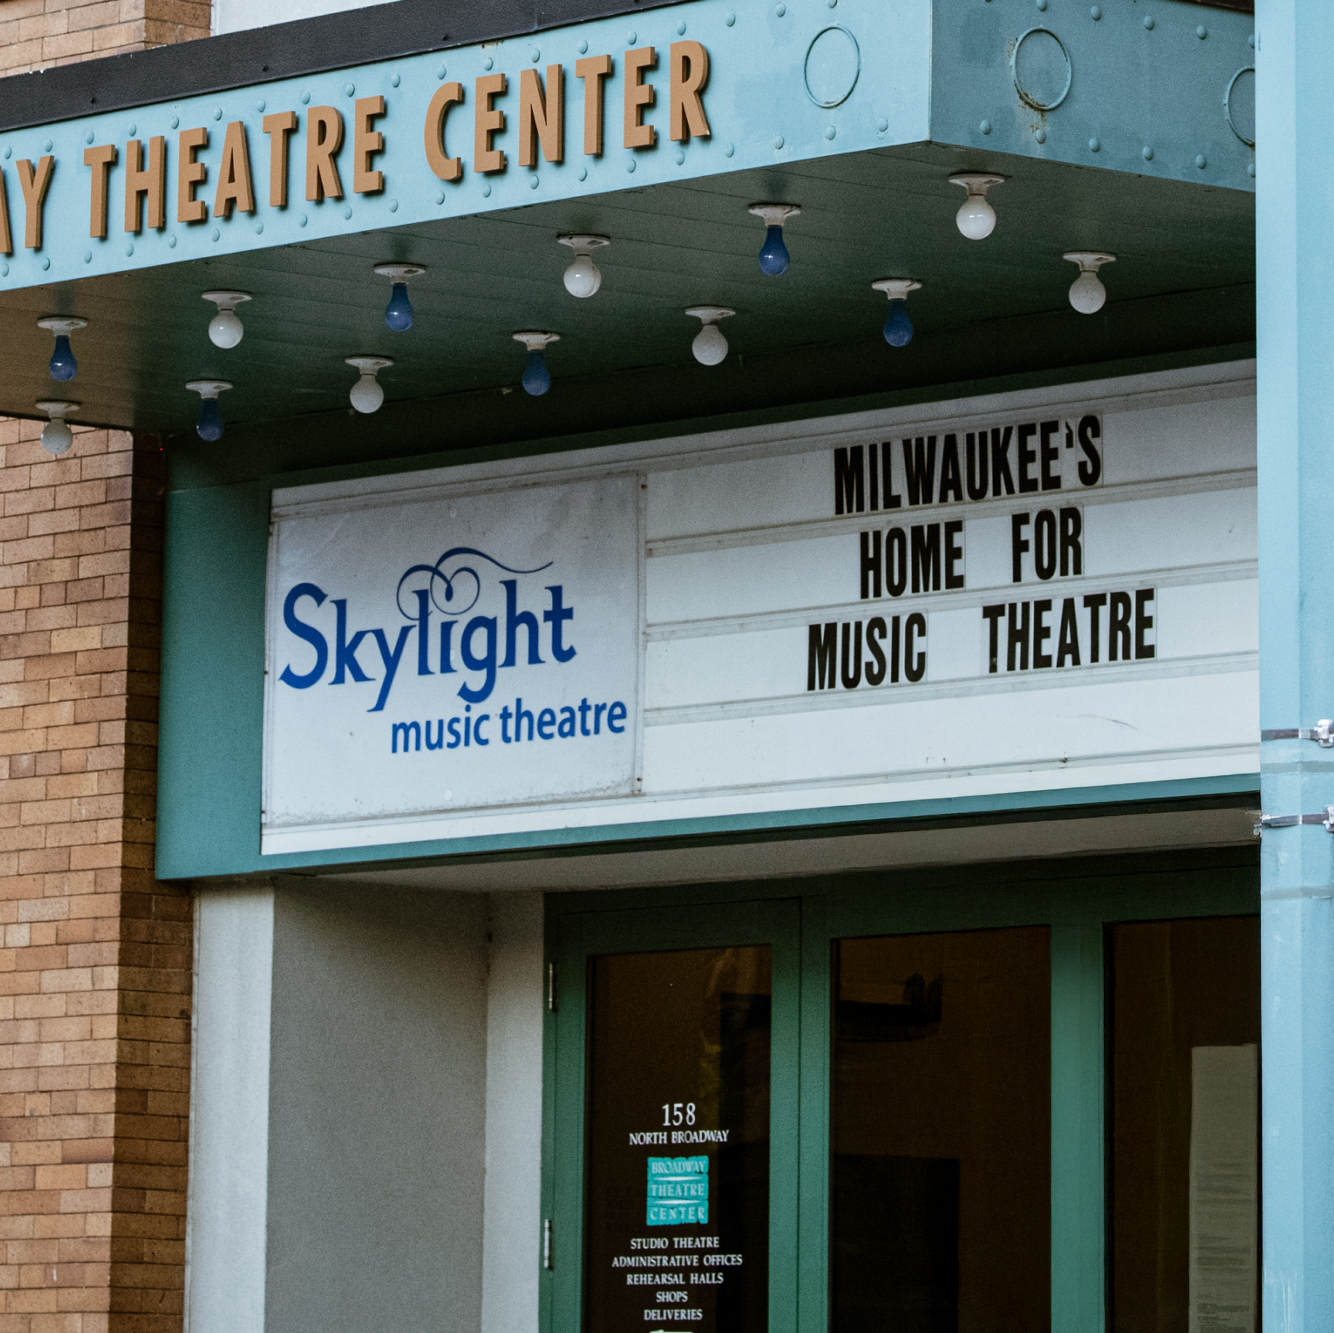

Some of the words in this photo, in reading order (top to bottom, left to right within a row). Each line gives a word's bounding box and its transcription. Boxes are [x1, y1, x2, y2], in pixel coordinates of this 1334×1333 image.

[83, 94, 385, 239] THEATRE
[424, 40, 711, 181] CENTER
[834, 414, 1103, 516] MILWAUKEE'S
[860, 520, 965, 599] HOME
[1011, 507, 1083, 583] FOR
[278, 547, 579, 712] Skylight
[807, 612, 927, 692] MUSIC
[983, 588, 1156, 674] THEATRE
[391, 704, 491, 754] music
[498, 693, 628, 745] theatre
[662, 1102, 696, 1126] 158
[629, 1132, 668, 1145] NORTH
[671, 1129, 730, 1144] BROADWAY
[651, 1161, 706, 1174] BROADWAY
[651, 1183, 705, 1197] THEATRE
[650, 1207, 705, 1220] CENTER
[630, 1238, 669, 1250] STUDIO
[673, 1237, 720, 1249] THEATRE
[612, 1255, 699, 1268] ADMINISTRATIVE
[703, 1254, 743, 1266] OFFICES
[626, 1274, 686, 1286] REHEARSAL
[690, 1272, 724, 1285] HALLS
[656, 1291, 688, 1303] SHOPS
[643, 1308, 703, 1321] DELIVERIES
